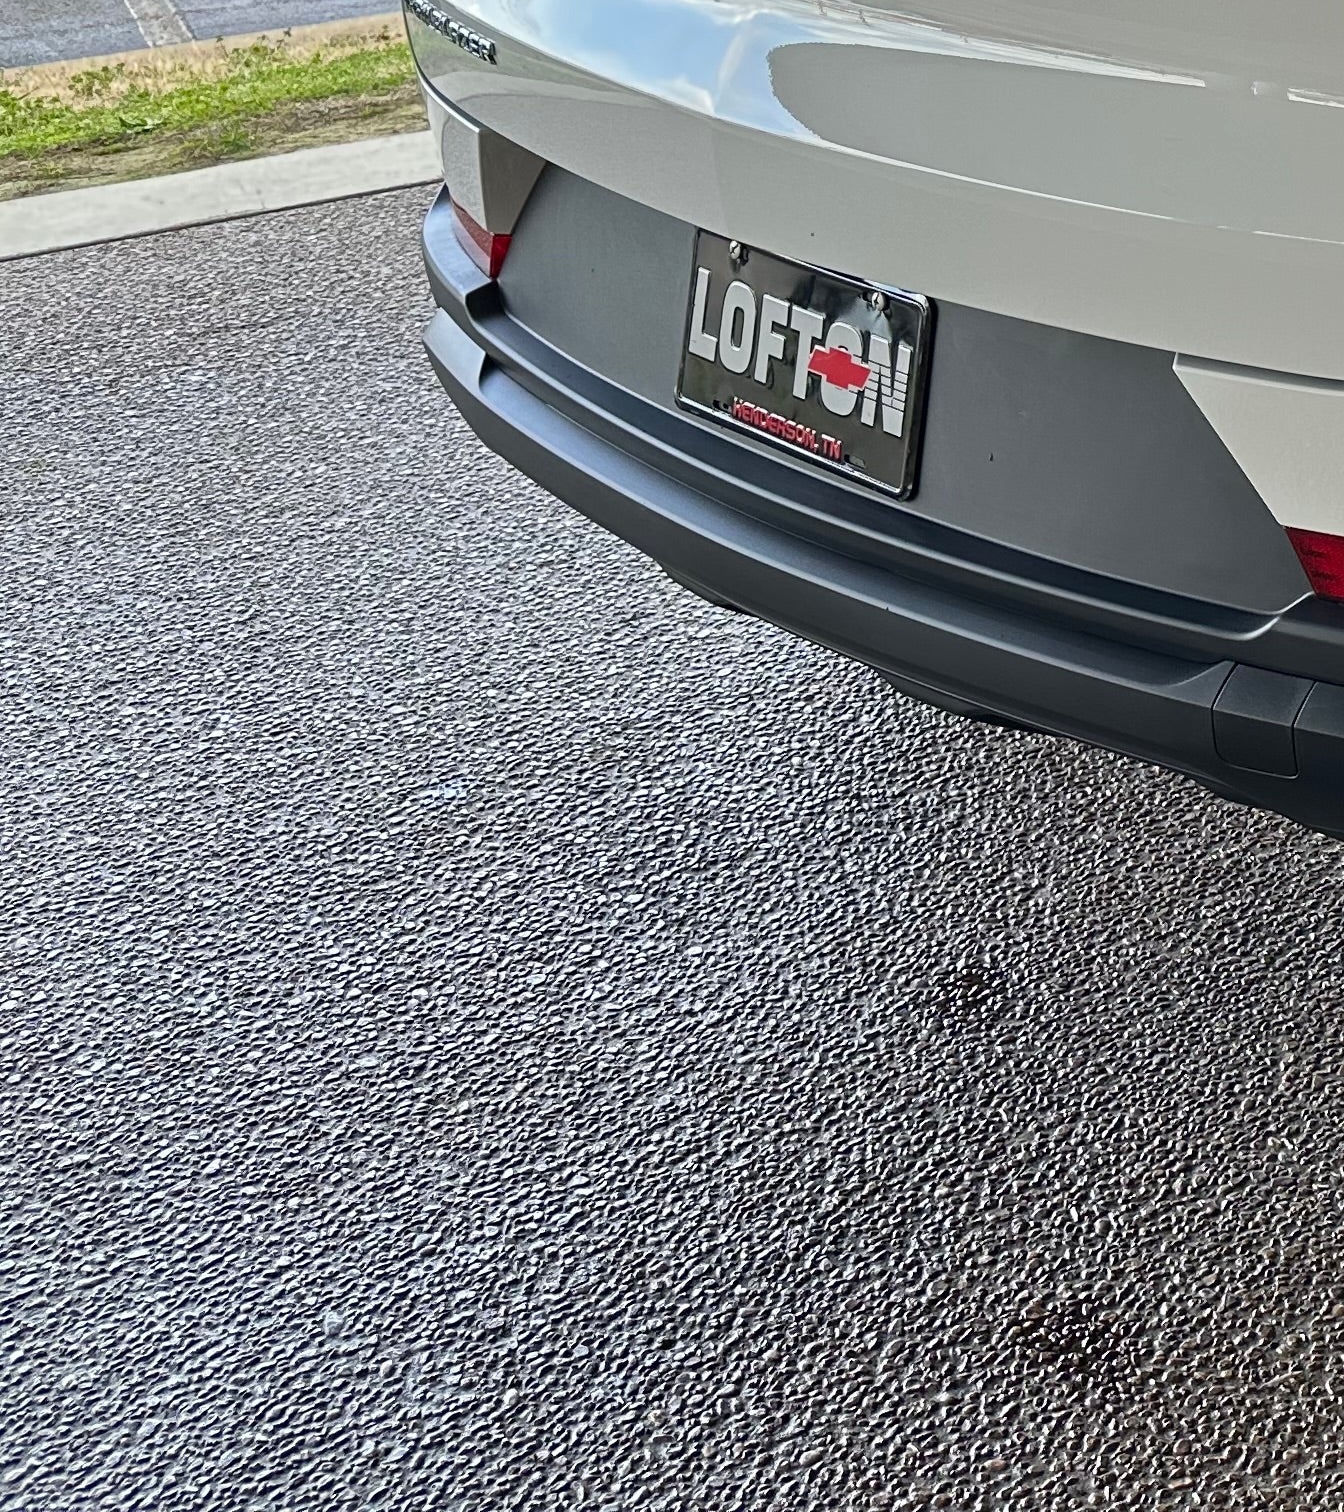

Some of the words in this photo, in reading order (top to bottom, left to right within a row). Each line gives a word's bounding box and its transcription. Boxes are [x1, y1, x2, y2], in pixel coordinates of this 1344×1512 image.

[688, 267, 912, 438] LOFTON
[732, 396, 819, 453] HENDERSON,
[821, 433, 842, 460] TN
